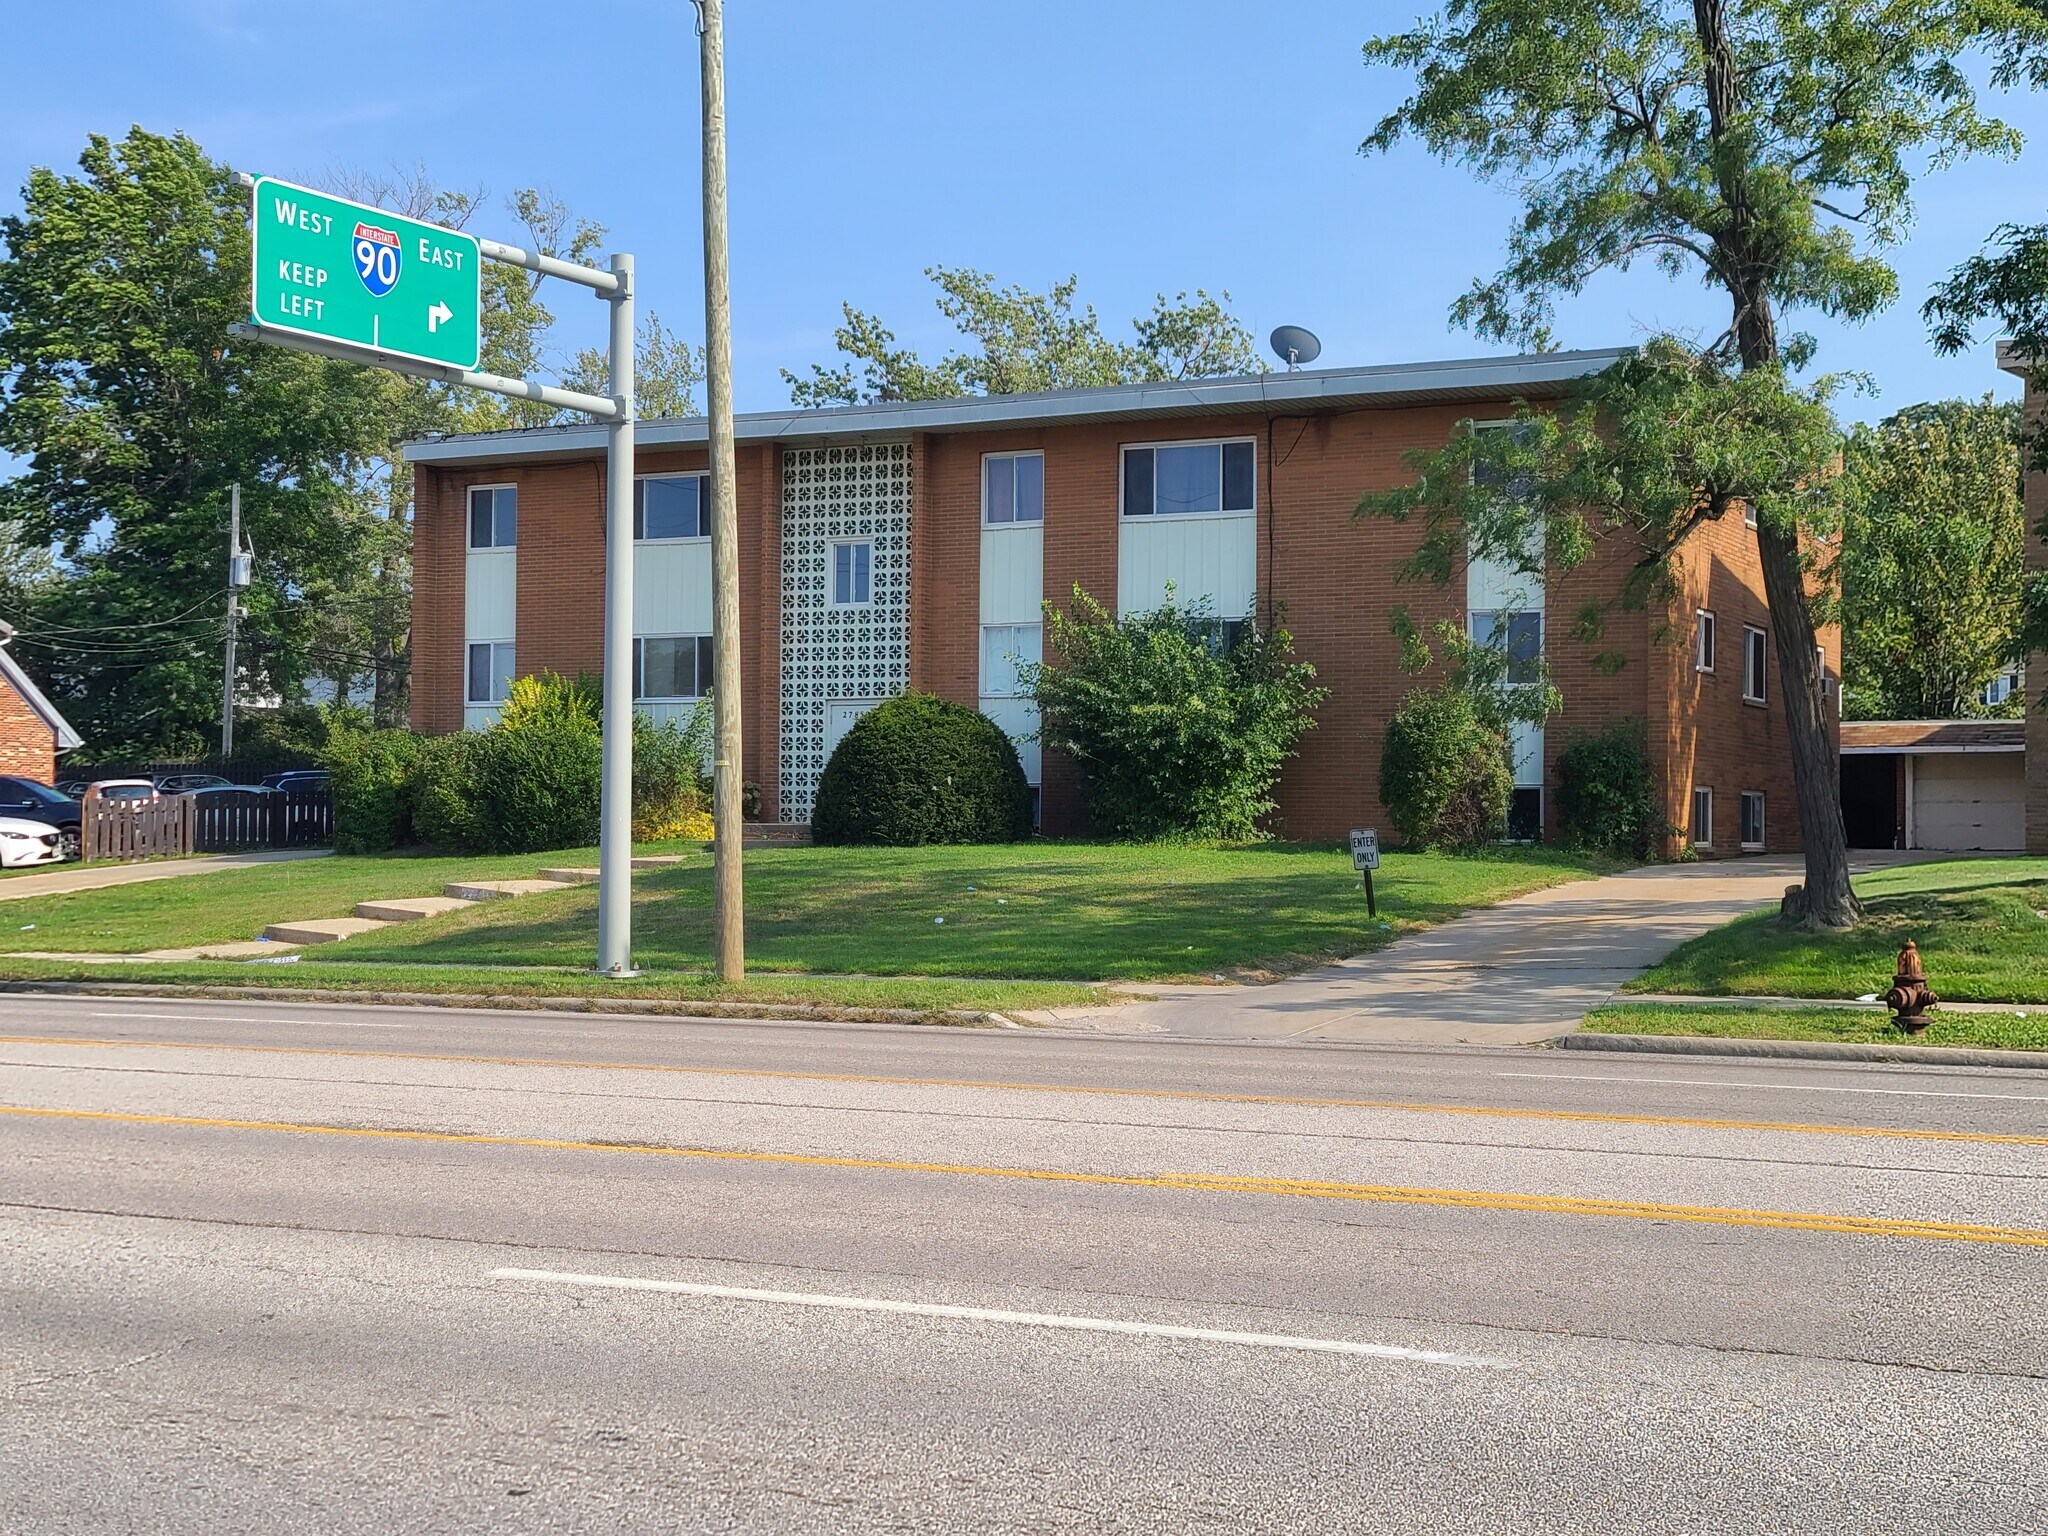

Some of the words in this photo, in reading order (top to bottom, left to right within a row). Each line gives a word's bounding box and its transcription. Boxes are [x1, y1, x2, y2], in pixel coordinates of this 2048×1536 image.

[274, 197, 333, 236] WEST
[360, 226, 395, 245] INTERSTATE
[356, 240, 397, 286] 90
[419, 237, 464, 272] EAST
[279, 259, 328, 288] KEEP
[280, 292, 325, 321] LEFT
[1352, 836, 1375, 848] ENTER
[1356, 851, 1375, 863] ONLY
